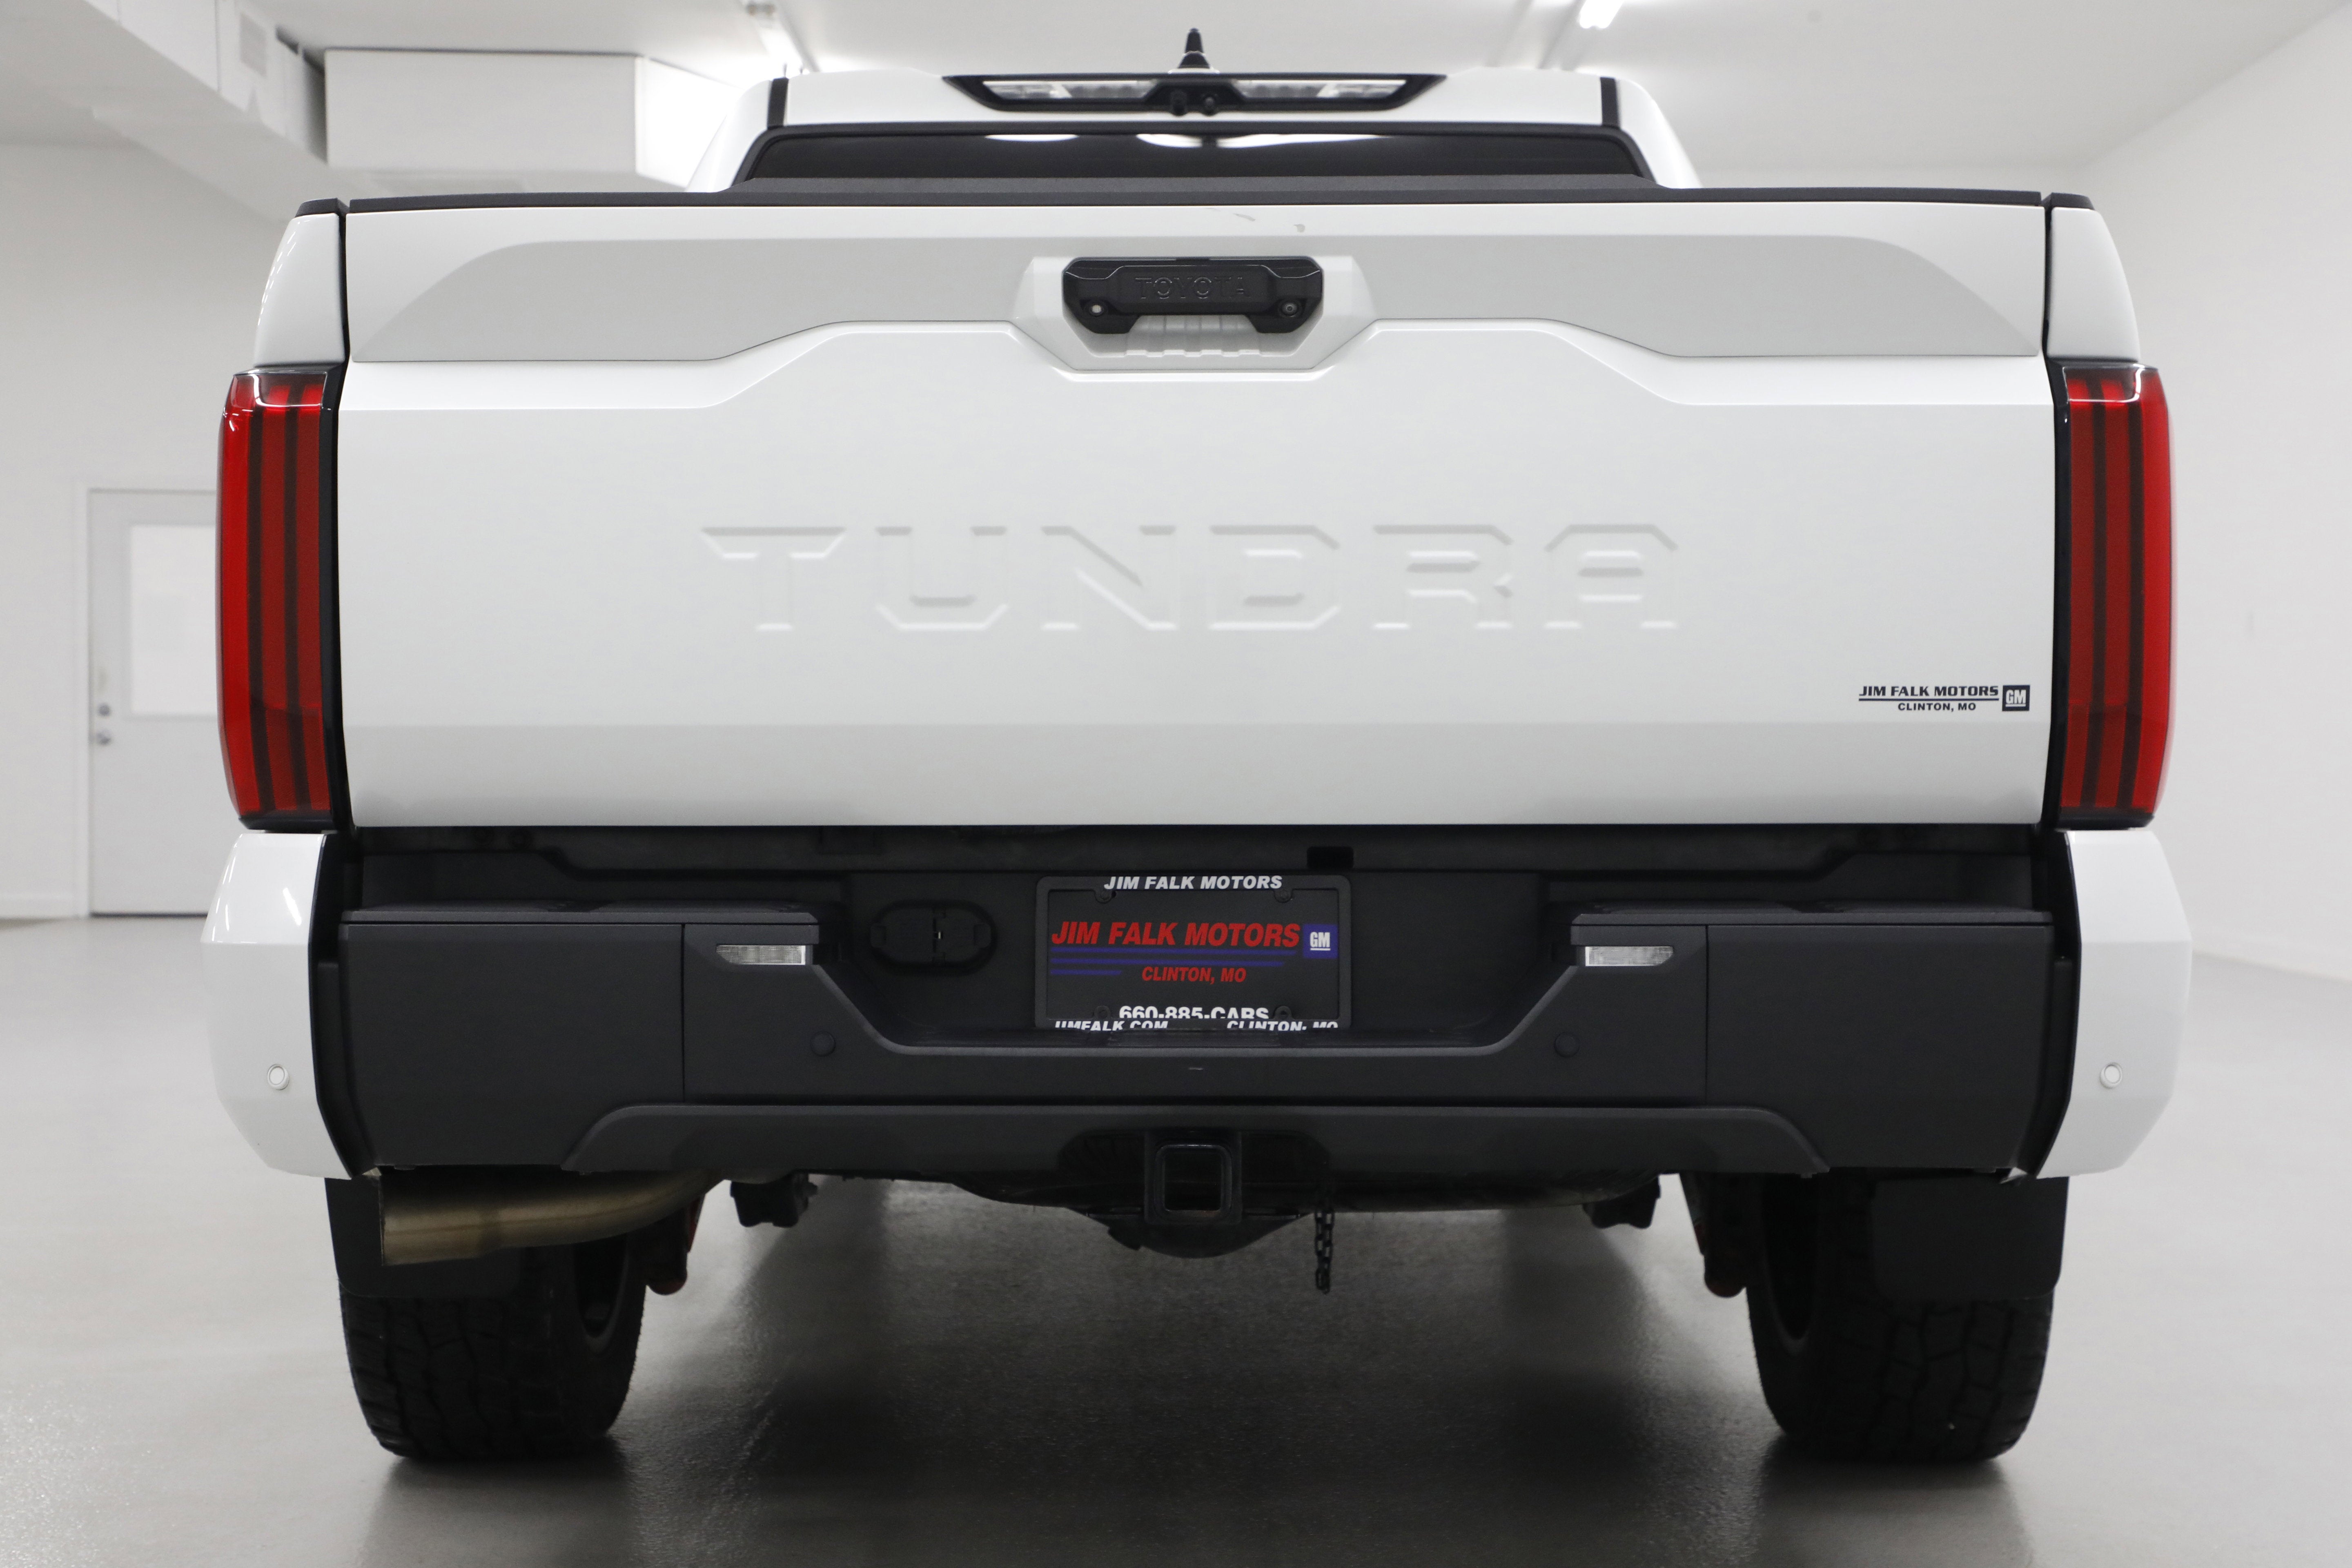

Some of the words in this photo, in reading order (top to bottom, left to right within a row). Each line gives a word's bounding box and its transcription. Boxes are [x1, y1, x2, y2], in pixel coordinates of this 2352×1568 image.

[1135, 276, 1252, 298] TOYOTA
[701, 524, 1677, 630] TUNDRA
[1859, 686, 1886, 697] JIM
[1891, 686, 1929, 697] FALK
[1934, 686, 1999, 697] MOTORS
[2006, 689, 2027, 704] GM
[1898, 702, 1954, 712] CLINTON,
[1958, 702, 1976, 710] MO
[1104, 876, 1140, 889] JIM
[1144, 876, 1195, 889] FALK
[1200, 875, 1283, 889] MOTORS
[1051, 921, 1100, 944] JIM
[1108, 922, 1178, 946] FALK
[1184, 923, 1301, 947] MOTORS
[1310, 931, 1330, 947] GM
[1142, 967, 1215, 985] CLINTON,
[1220, 968, 1247, 983] MO
[1119, 1005, 1269, 1019] 660-885-CARS
